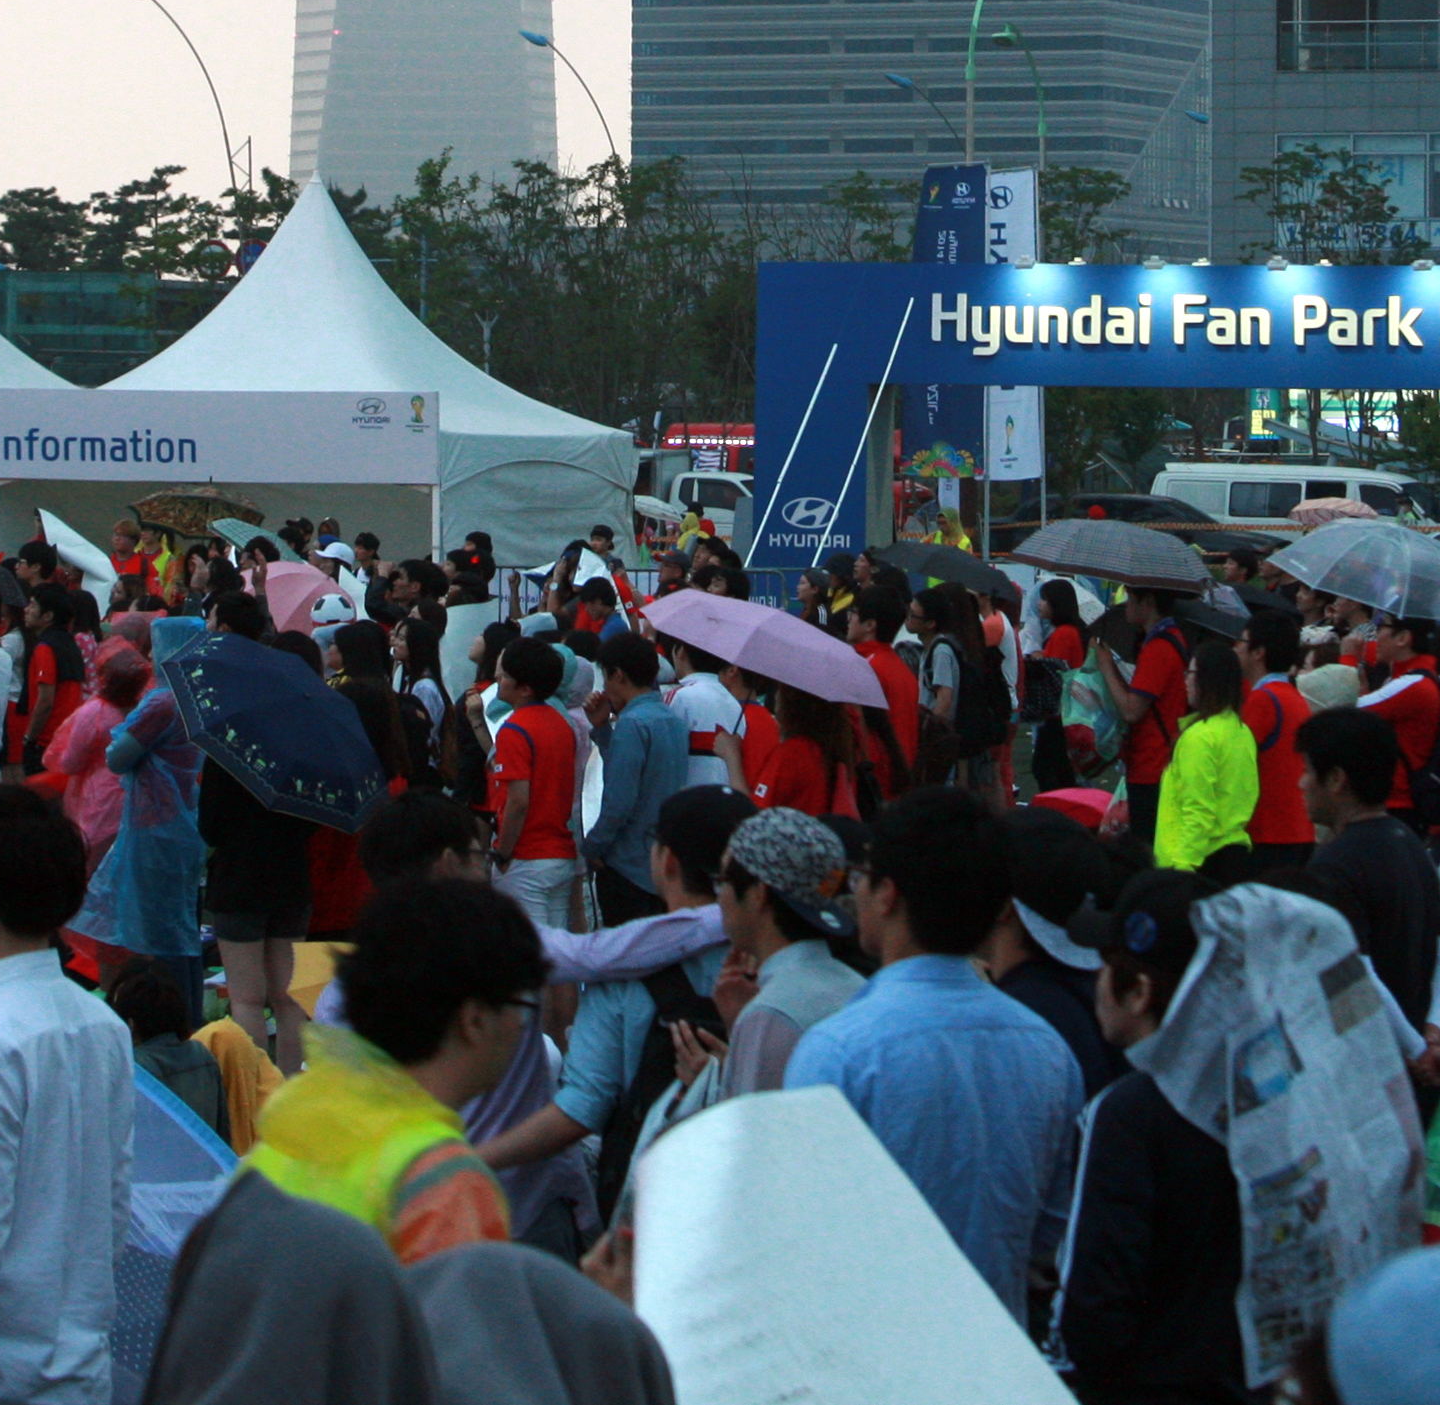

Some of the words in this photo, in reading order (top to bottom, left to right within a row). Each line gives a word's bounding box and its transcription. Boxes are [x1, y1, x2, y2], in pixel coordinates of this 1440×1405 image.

[931, 292, 1152, 356] Hyundai
[1173, 294, 1272, 347] Fan
[1293, 295, 1424, 348] Park
[352, 416, 391, 424] HYUNDAI
[769, 533, 851, 548] HYUNDAI
